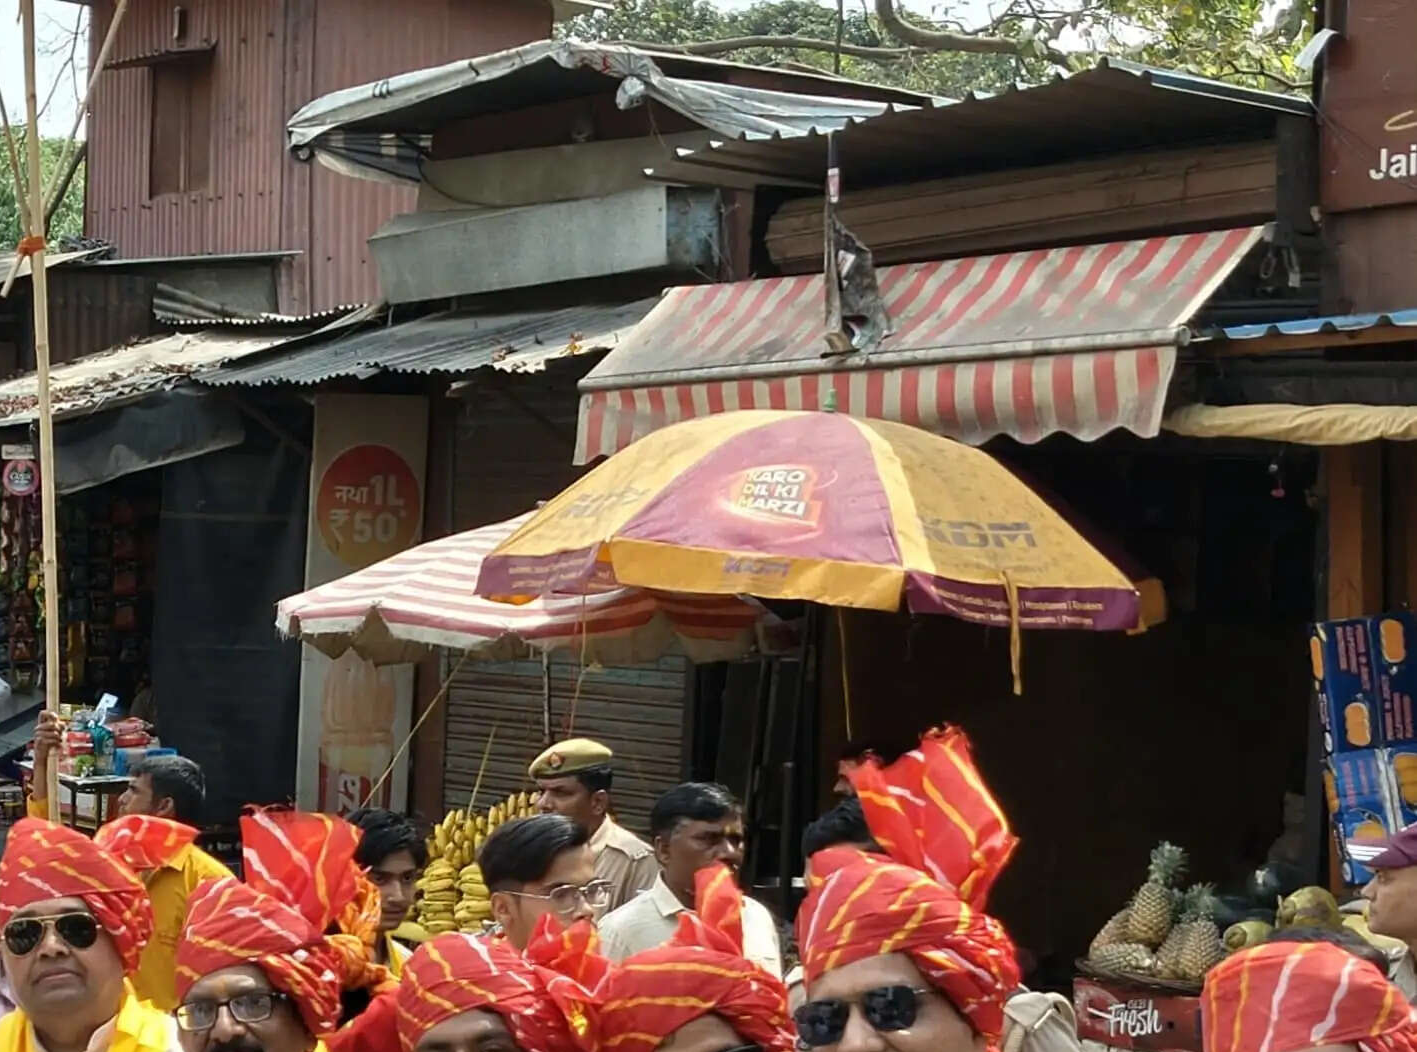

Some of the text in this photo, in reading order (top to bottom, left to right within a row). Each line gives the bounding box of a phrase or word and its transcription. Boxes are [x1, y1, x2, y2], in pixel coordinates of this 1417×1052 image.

[746, 469, 807, 484] KARO
[333, 484, 368, 503] नया
[742, 483, 800, 499] DIL KI
[737, 495, 807, 517] MARZI
[1101, 999, 1163, 1038] Fresh
